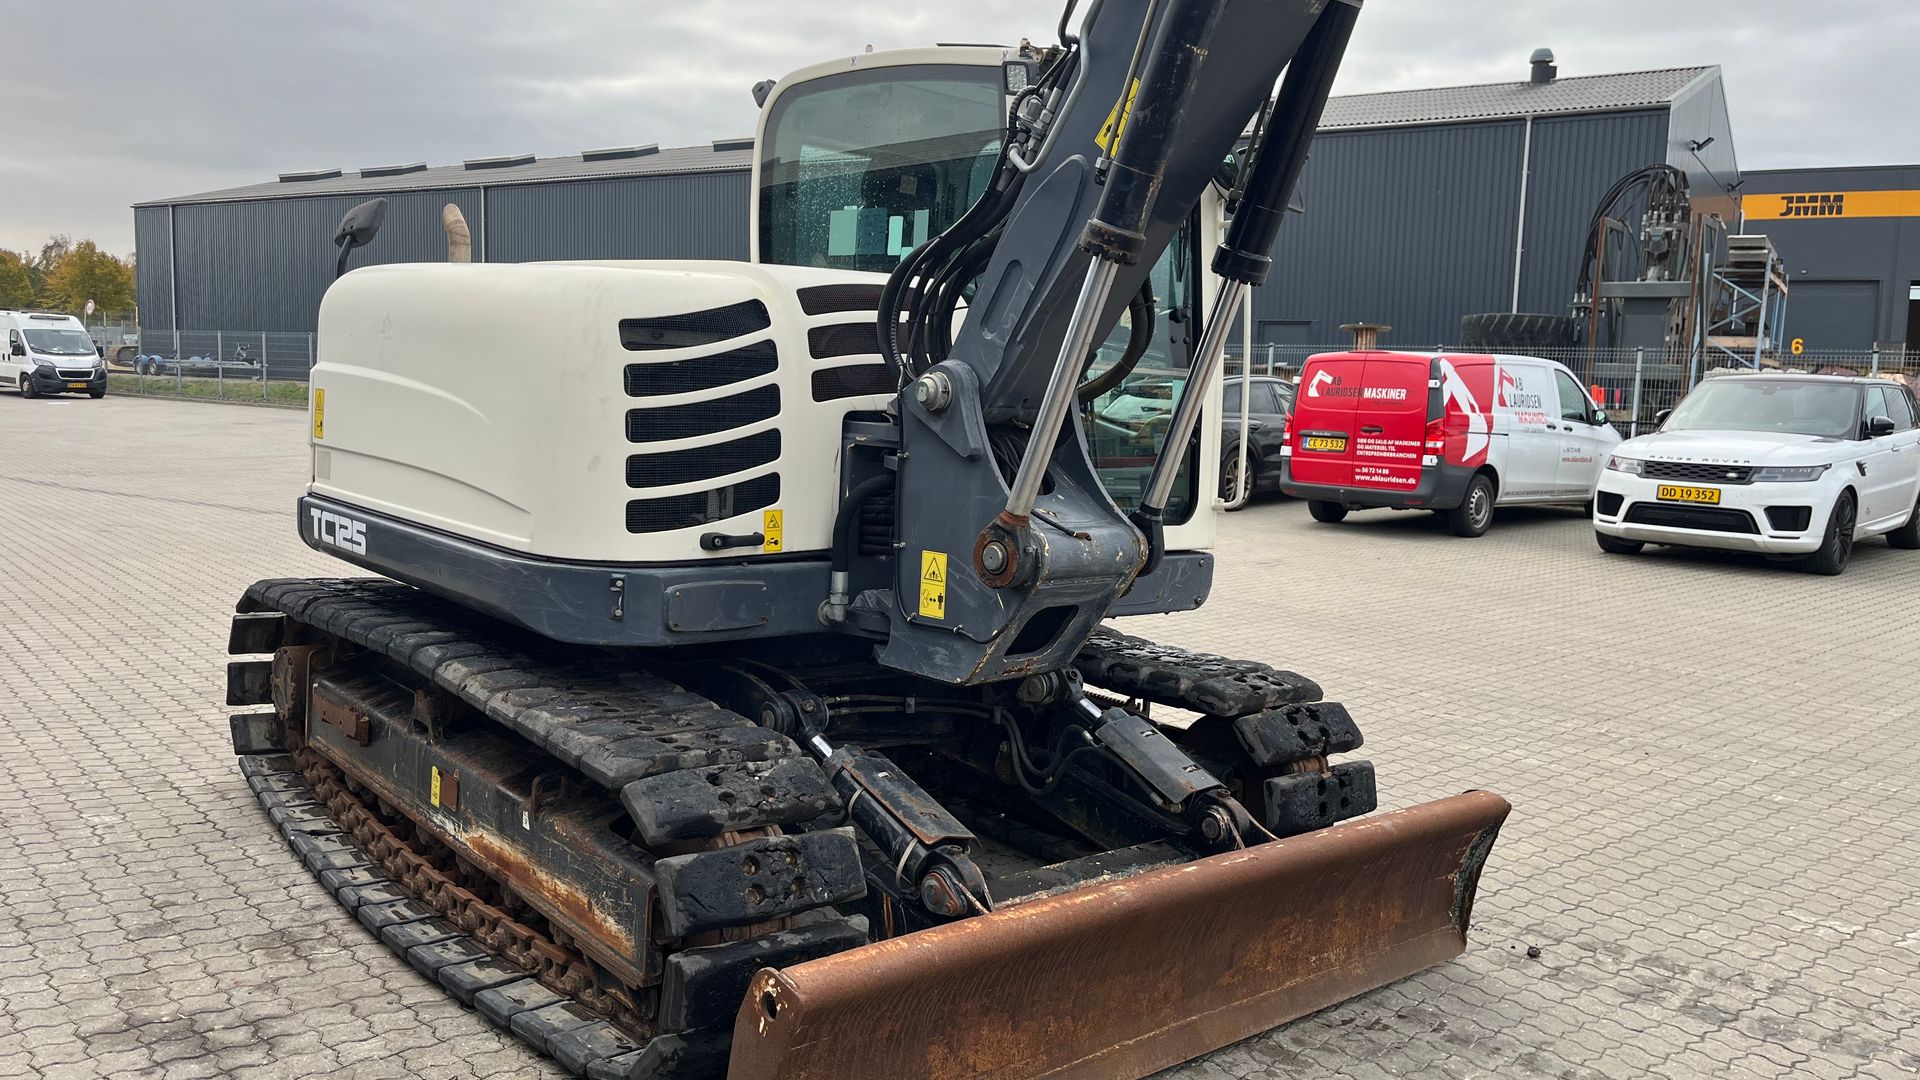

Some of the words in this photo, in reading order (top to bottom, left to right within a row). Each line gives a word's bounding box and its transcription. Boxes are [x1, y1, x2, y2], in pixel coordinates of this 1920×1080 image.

[1779, 194, 1844, 216] JMM
[1791, 338, 1804, 355] 6
[1332, 376, 1342, 386] AB
[1514, 377, 1523, 391] AB
[1363, 387, 1407, 400] MASKINER
[1308, 439, 1318, 447] CE
[1319, 440, 1329, 448] 73
[1330, 440, 1344, 449] 532
[1355, 475, 1416, 484] www.ablauridsen.dk
[1661, 487, 1677, 498] DD
[1679, 488, 1692, 499] 19
[1693, 489, 1715, 501] 352
[310, 507, 367, 556] TC125
